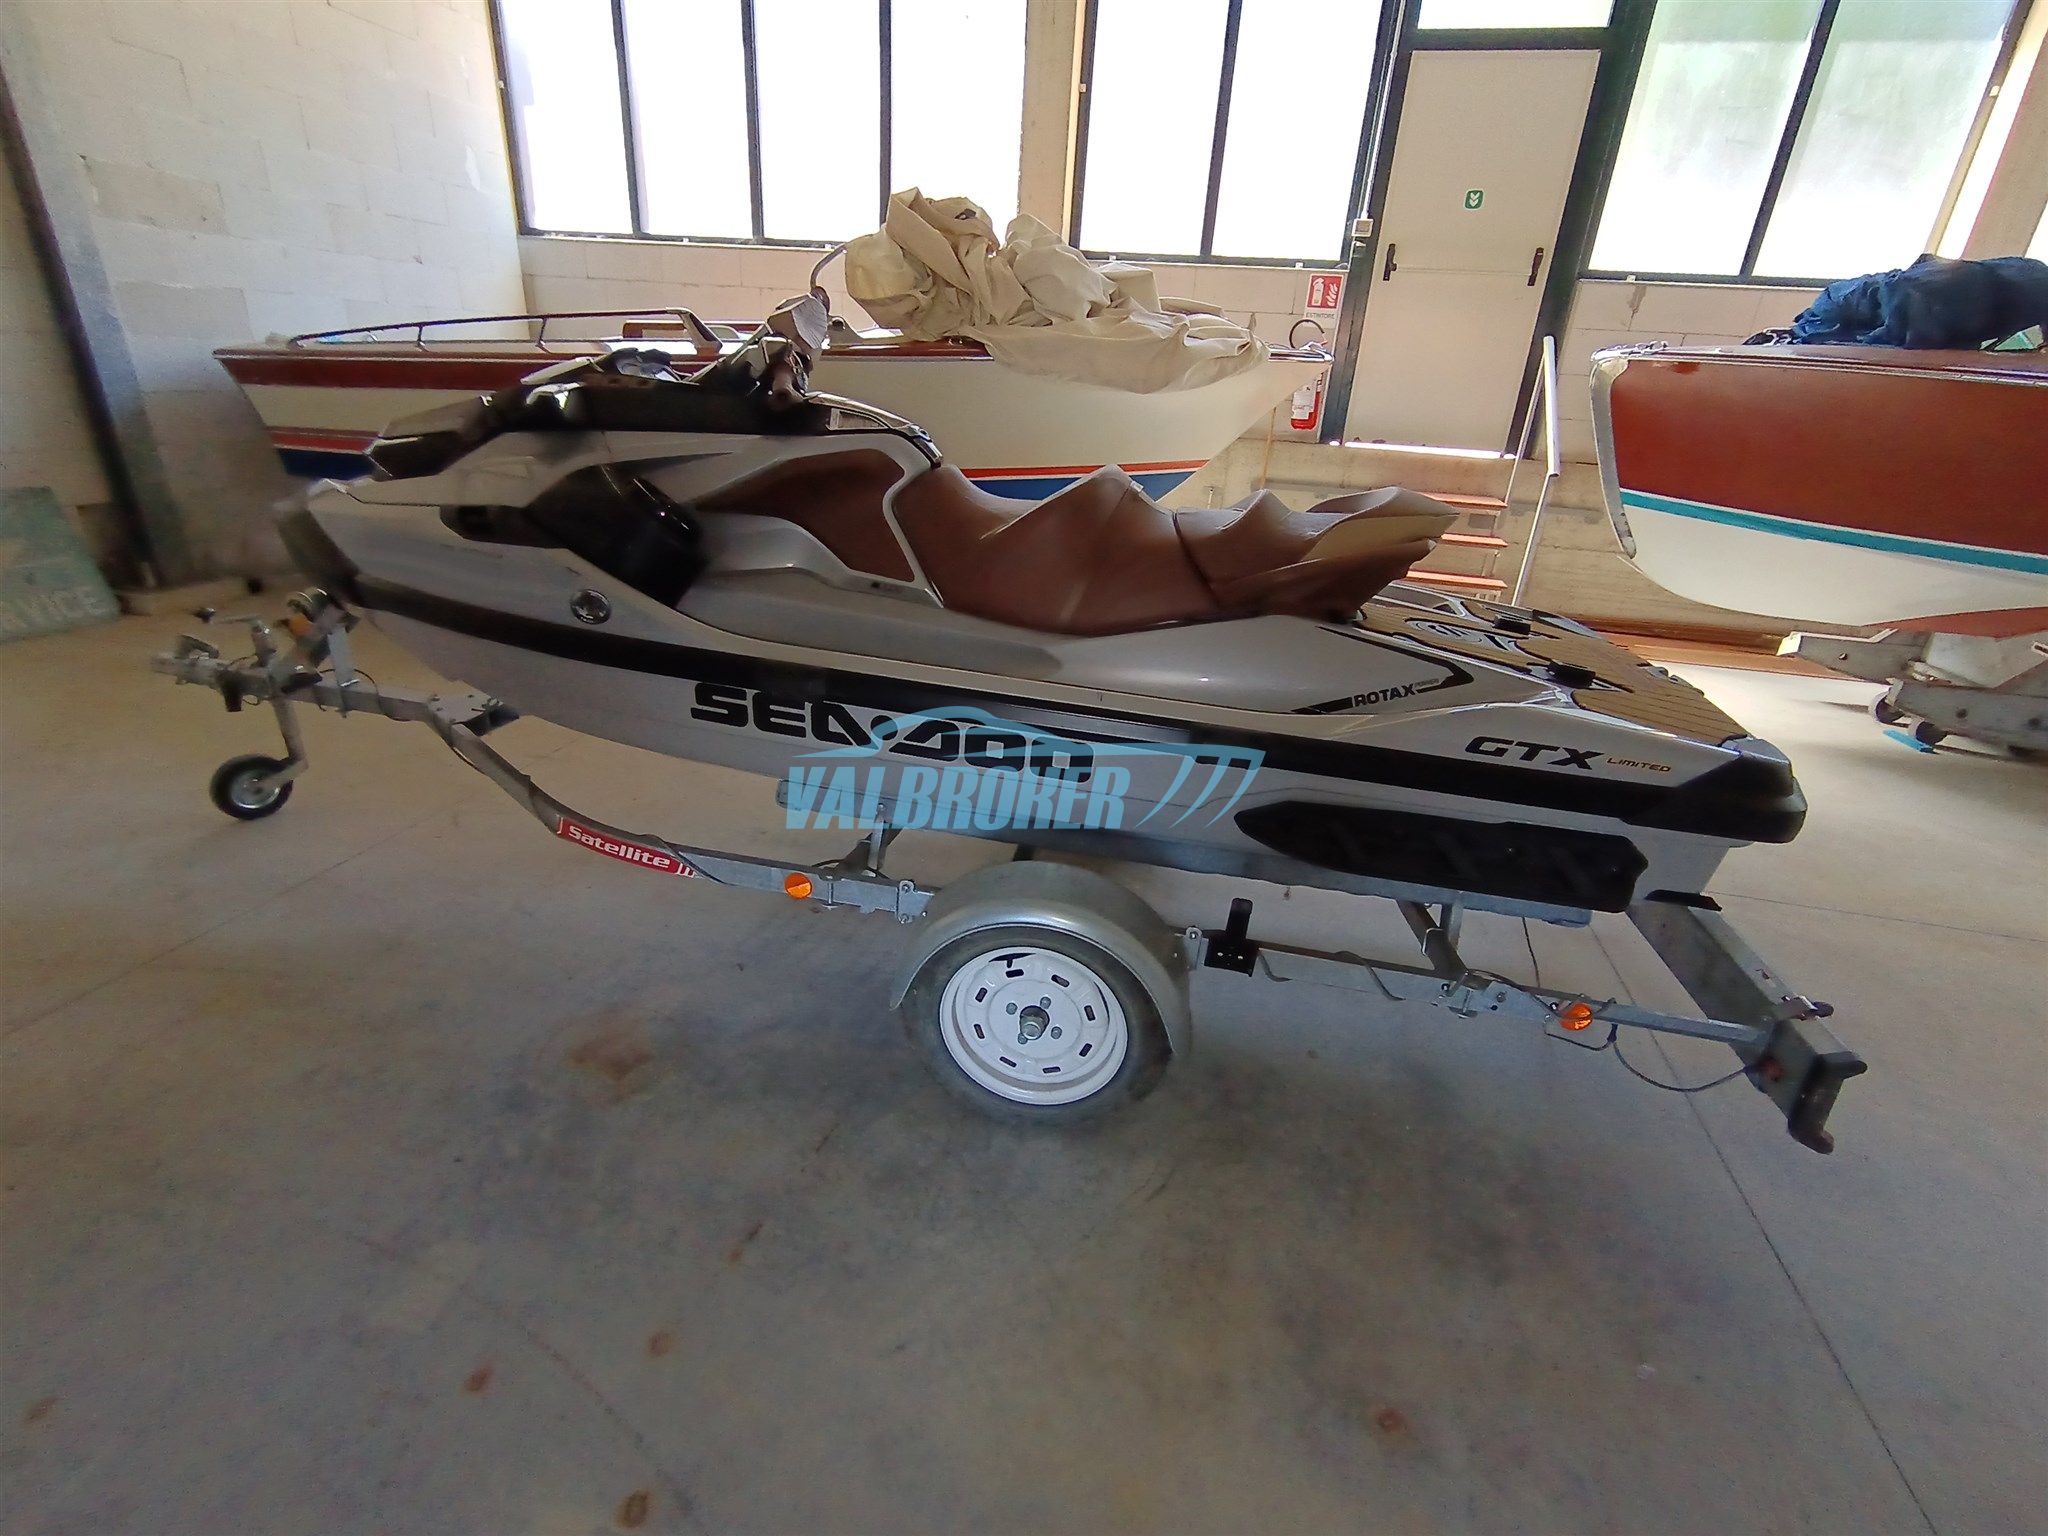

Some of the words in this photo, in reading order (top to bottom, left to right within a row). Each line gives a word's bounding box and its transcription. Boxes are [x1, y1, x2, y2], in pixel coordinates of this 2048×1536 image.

[1353, 683, 1416, 707] ROTAX
[1465, 736, 1605, 770] GTX
[1606, 757, 1671, 773] LIMITED
[568, 825, 671, 868] Satellite
